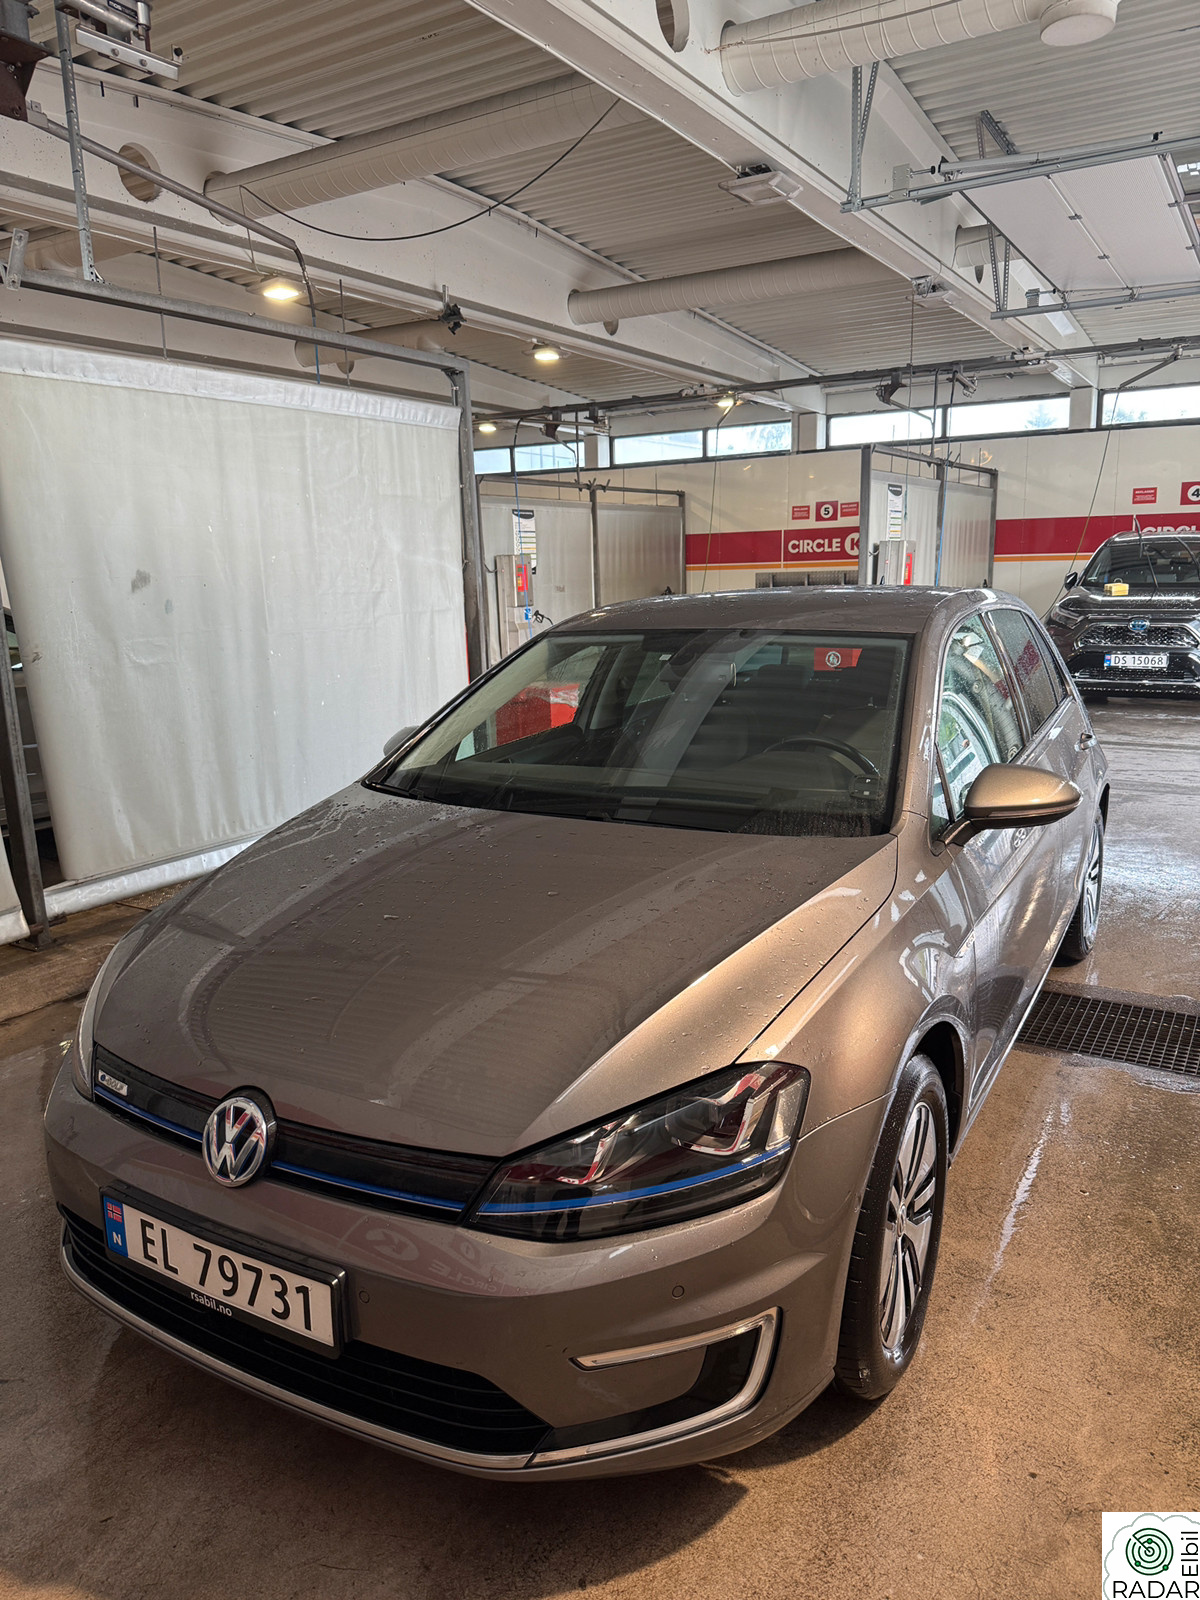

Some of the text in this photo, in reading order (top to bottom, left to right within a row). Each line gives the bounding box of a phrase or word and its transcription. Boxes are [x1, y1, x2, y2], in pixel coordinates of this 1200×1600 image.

[1191, 488, 1200, 498] 4
[823, 507, 830, 516] 5
[788, 538, 841, 554] CIRCLE
[1114, 656, 1164, 666] DS 15068
[113, 1231, 122, 1247] N
[140, 1218, 312, 1332] EL 79731
[190, 1291, 233, 1317] rsabil.no
